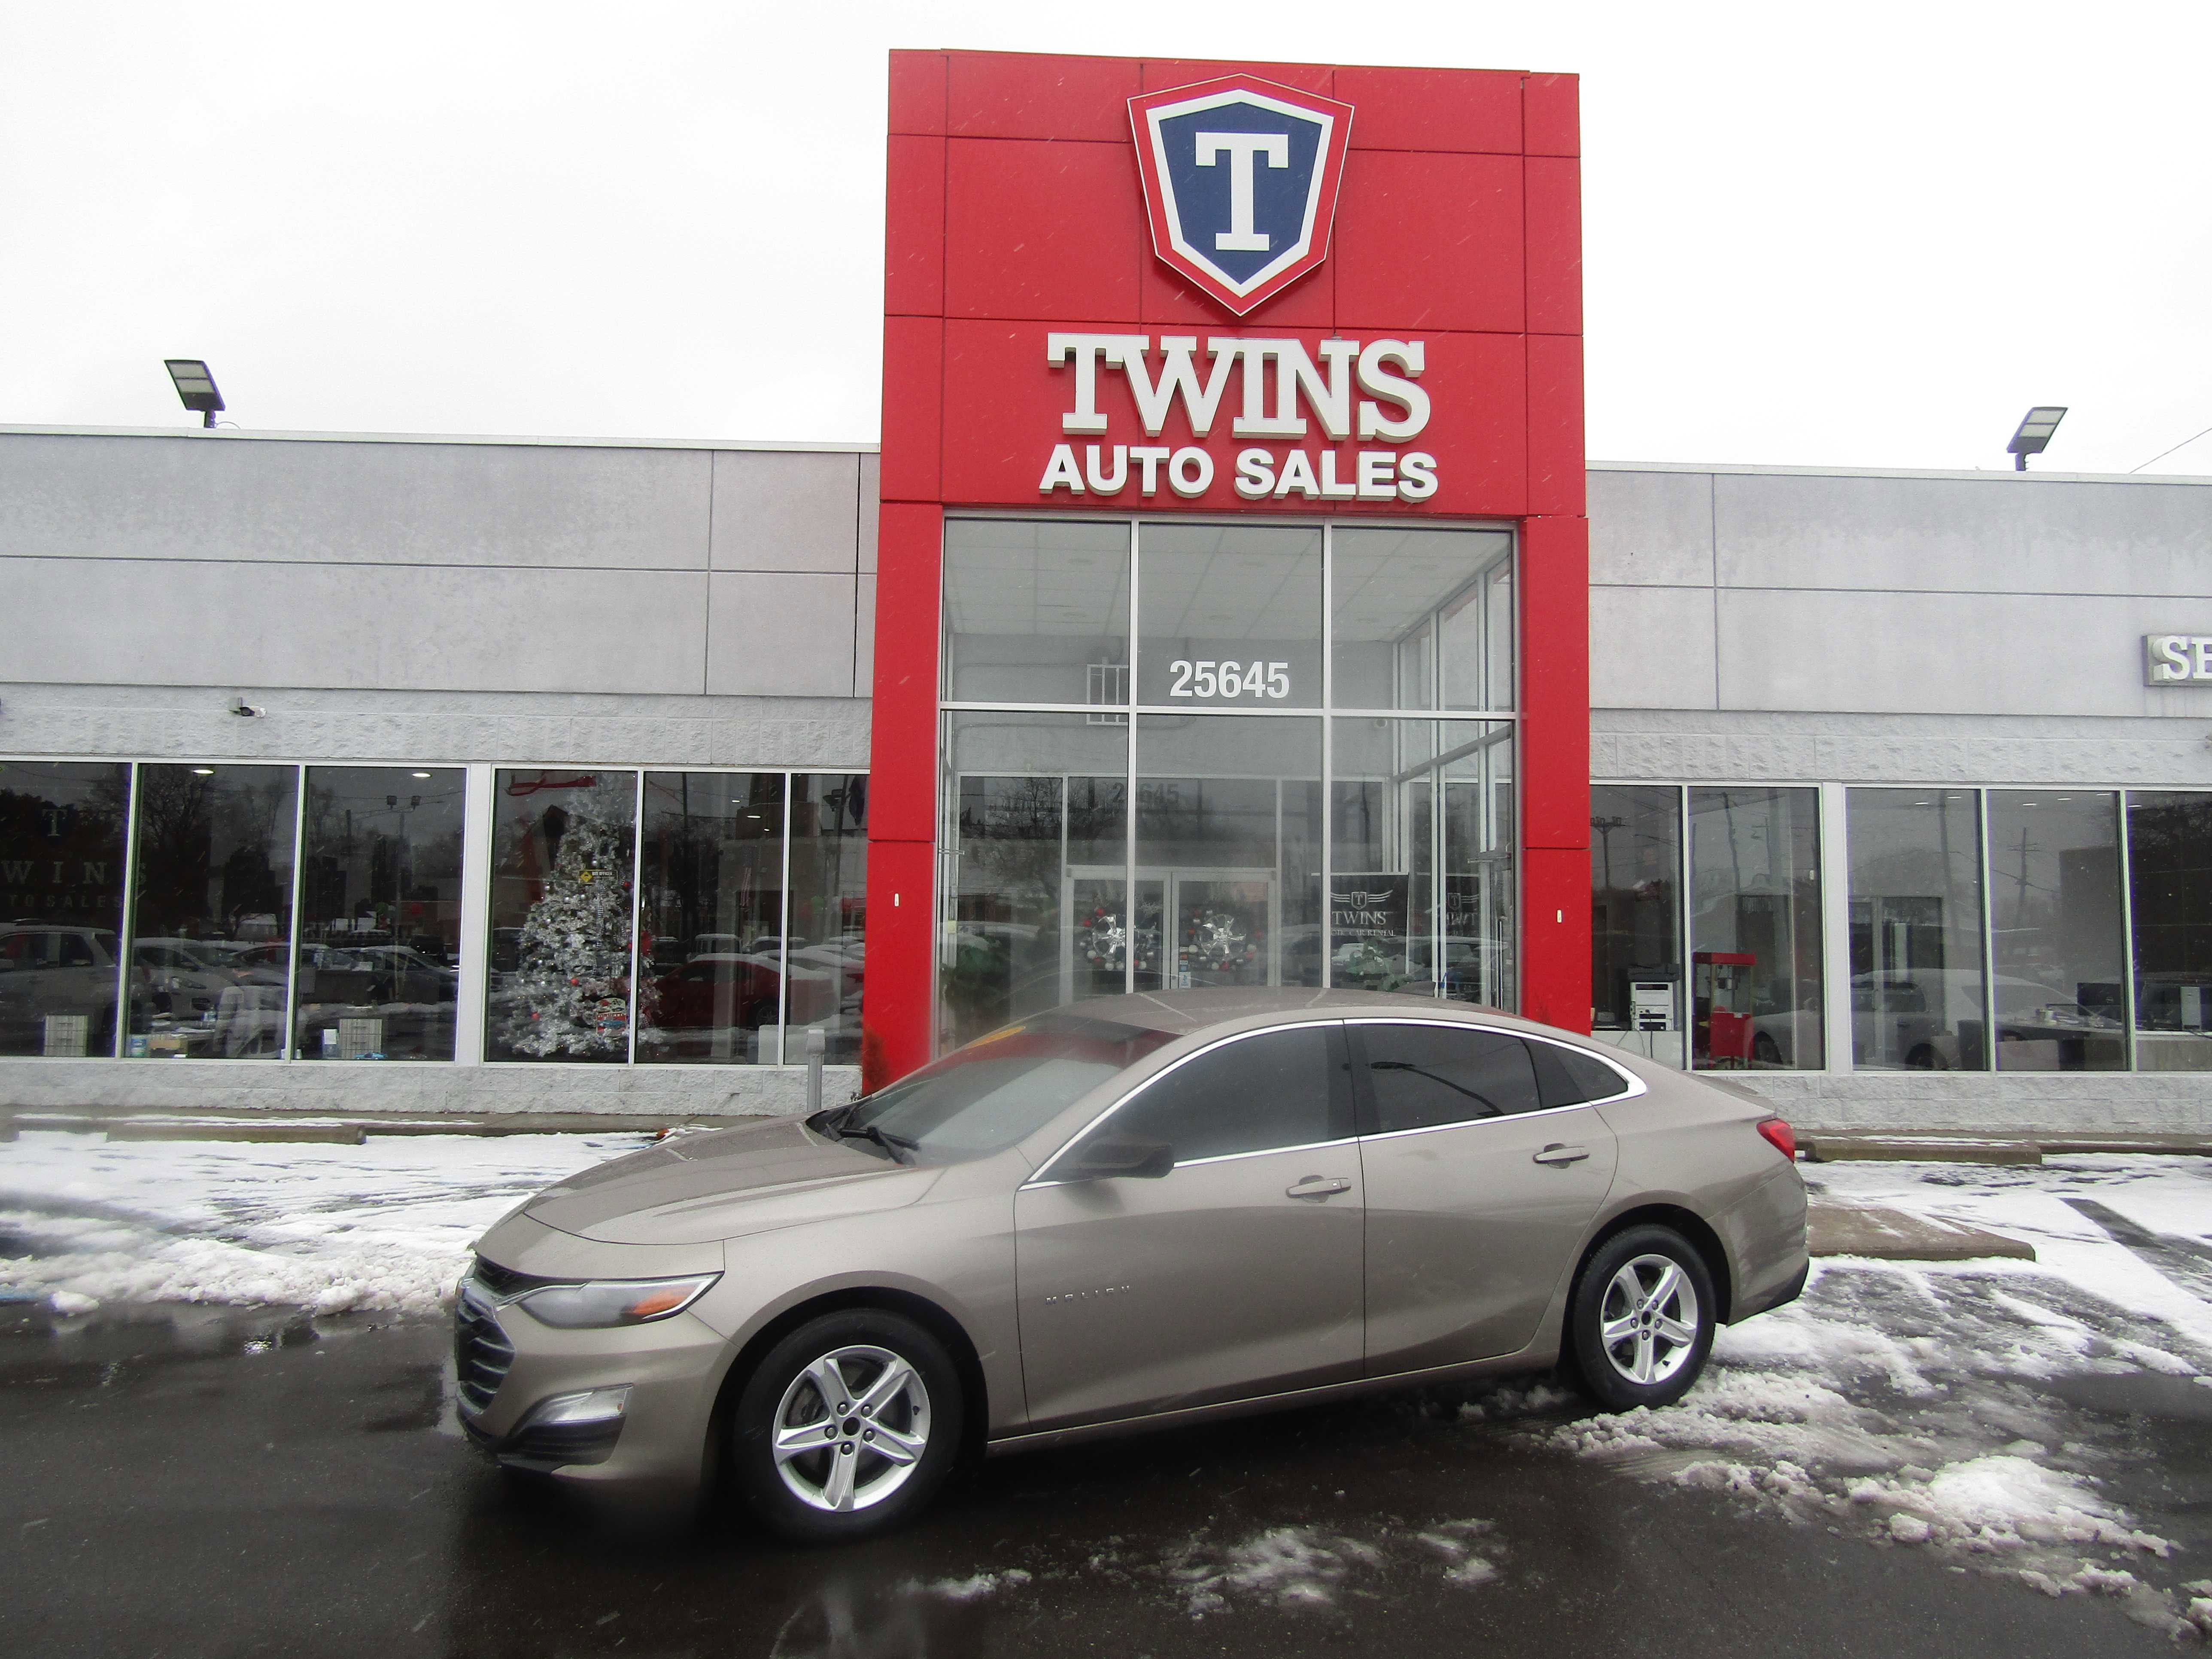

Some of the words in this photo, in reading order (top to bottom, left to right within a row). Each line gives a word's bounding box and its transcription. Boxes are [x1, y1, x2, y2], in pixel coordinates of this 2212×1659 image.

[1195, 132, 1288, 251] T
[1047, 332, 1431, 443] TWINS
[1039, 444, 1215, 498] AUTO
[1233, 447, 1439, 504] SALES
[1169, 660, 1289, 699] 25645
[1332, 911, 1386, 925] TWINS
[1349, 929, 1367, 937] CAR
[1367, 928, 1396, 937] RENTAL
